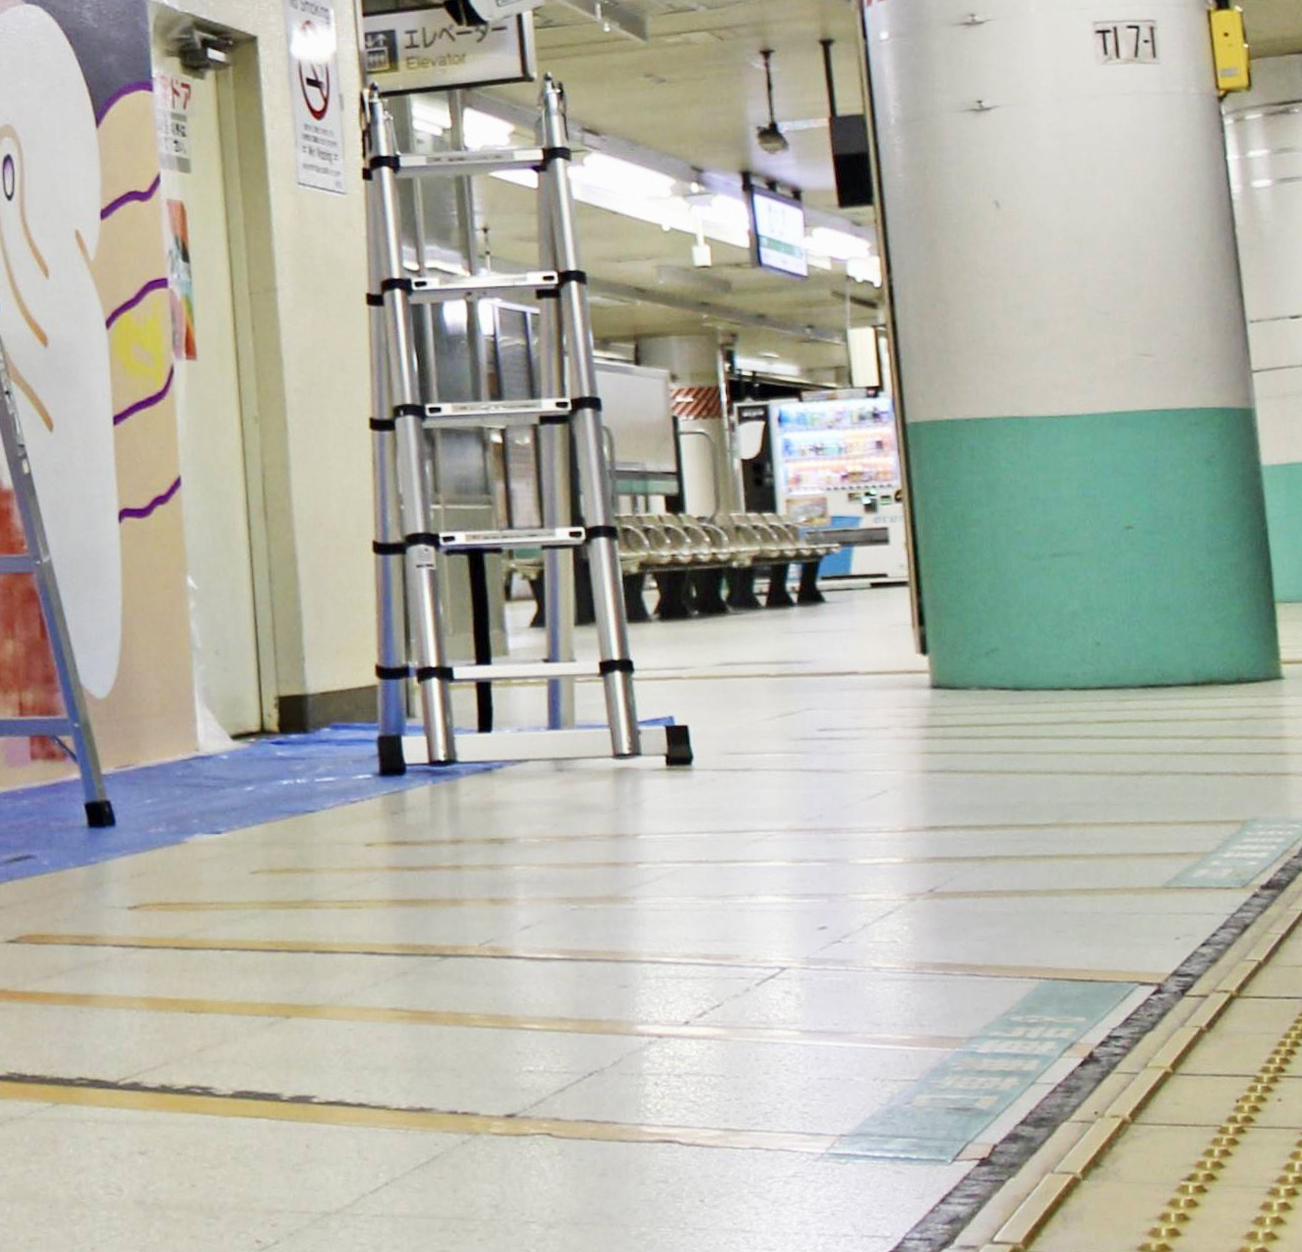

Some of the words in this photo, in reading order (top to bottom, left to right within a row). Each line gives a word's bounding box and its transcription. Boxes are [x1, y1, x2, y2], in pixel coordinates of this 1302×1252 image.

[404, 23, 508, 50] エレベーター
[405, 53, 467, 71] Elevator
